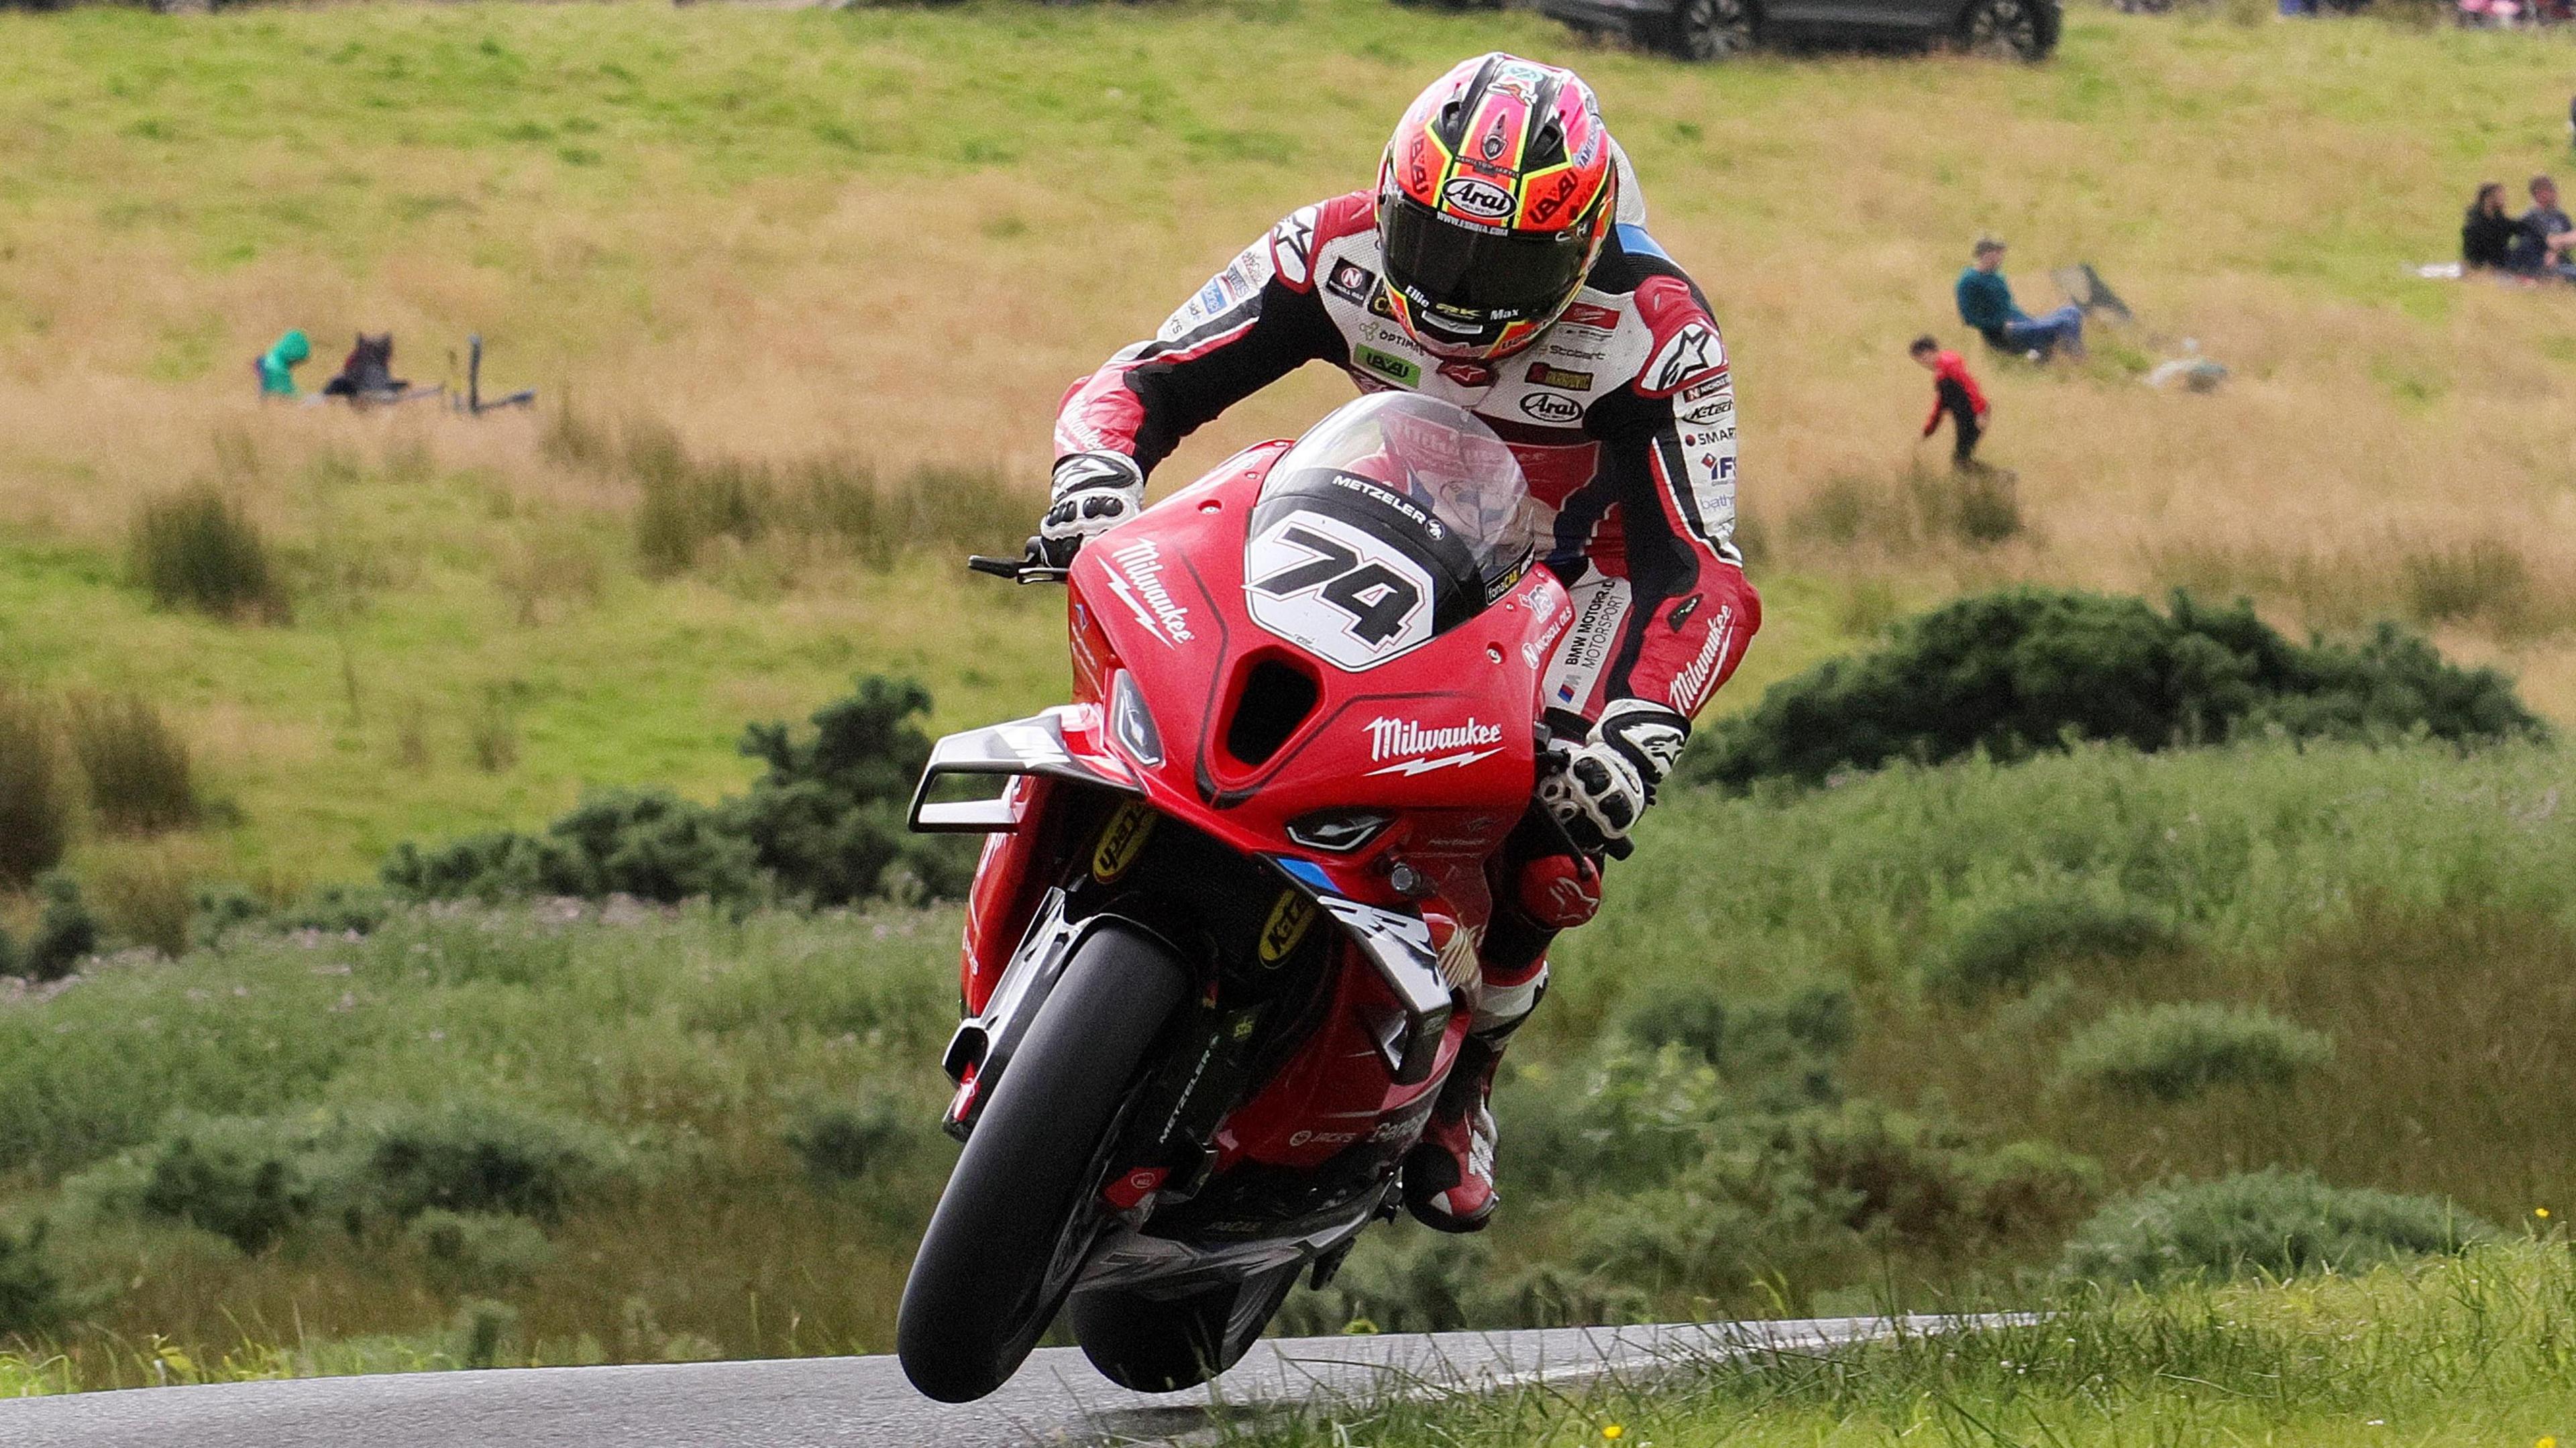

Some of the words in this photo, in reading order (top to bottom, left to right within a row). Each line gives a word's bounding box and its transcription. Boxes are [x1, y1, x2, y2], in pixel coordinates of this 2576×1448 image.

[1446, 182, 1507, 211] Arai
[1404, 284, 1430, 309] Ellie
[1490, 308, 1519, 321] Max
[1550, 345, 1606, 360] Stobart
[1526, 395, 1576, 416] Arai
[1332, 475, 1426, 525] METZELER
[1111, 537, 1193, 644] Milwaukee
[1242, 522, 1425, 653] 74
[1566, 636, 1587, 665] BMW
[1582, 595, 1625, 669] MOTORSPORT
[1669, 604, 1733, 717] Milwaukee
[1362, 716, 1502, 762] Milwaukee
[1159, 1049, 1210, 1144] METZELER
